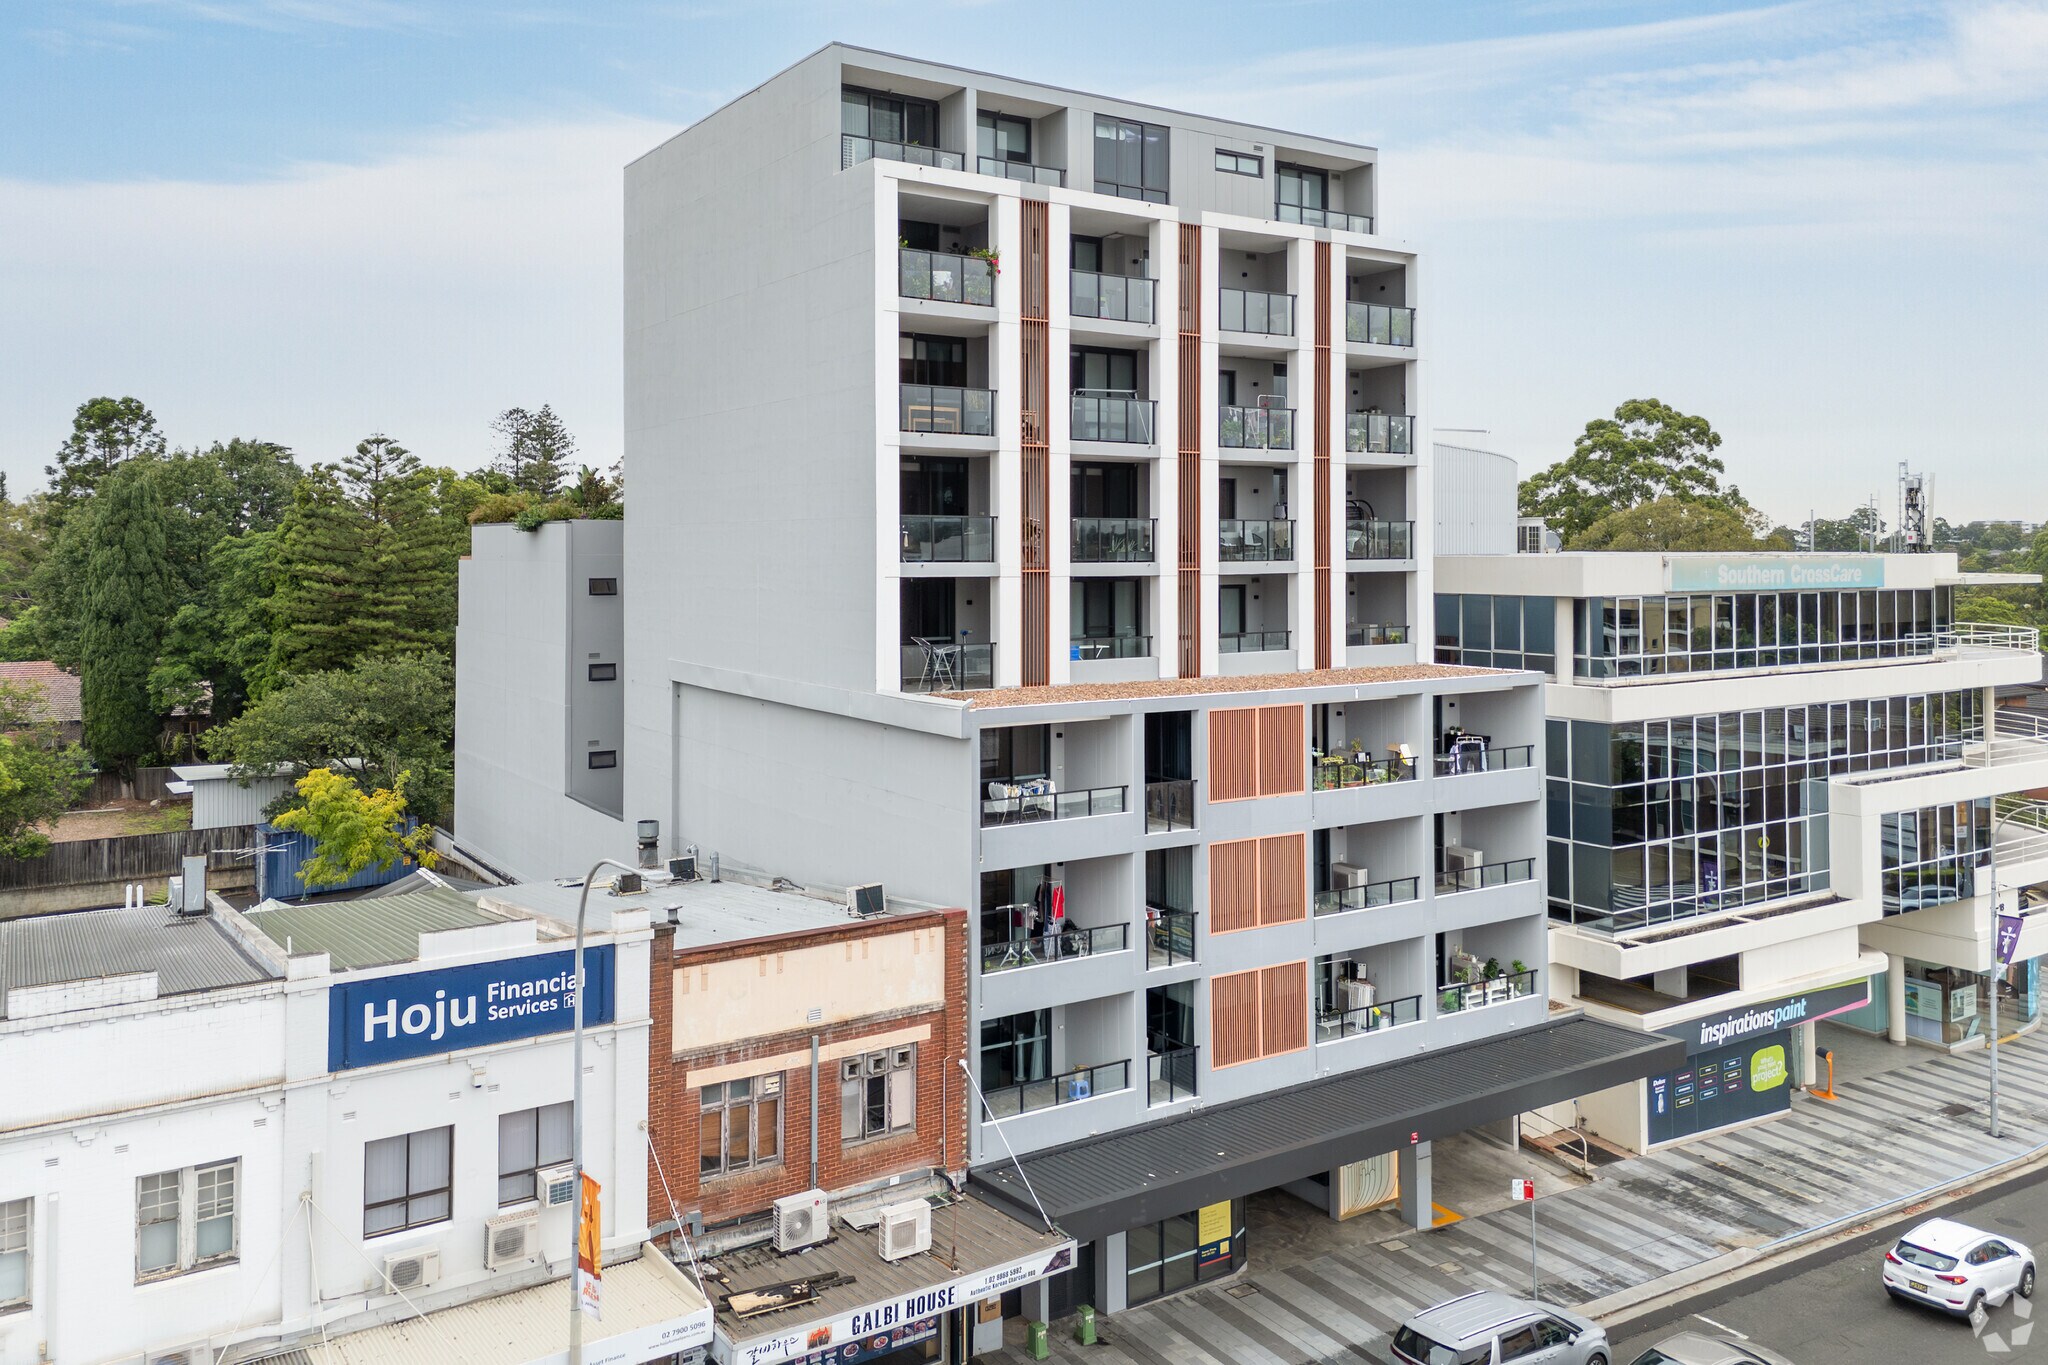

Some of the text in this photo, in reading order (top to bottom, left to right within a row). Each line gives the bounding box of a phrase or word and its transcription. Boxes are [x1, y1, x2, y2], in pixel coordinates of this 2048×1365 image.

[1718, 563, 1862, 585] Southern CrossCare
[487, 967, 586, 1003] Financial
[363, 989, 477, 1042] Hoju
[488, 999, 558, 1021] Services
[1752, 1060, 1783, 1087] project?
[970, 1285, 992, 1296] Authentic
[992, 1280, 1008, 1289] Korean
[851, 1285, 956, 1336] GALBI HOUSE
[661, 1320, 706, 1340] 02 7900 5096
[604, 1352, 626, 1364] Finance
[746, 1336, 800, 1365] 갈비하우스
